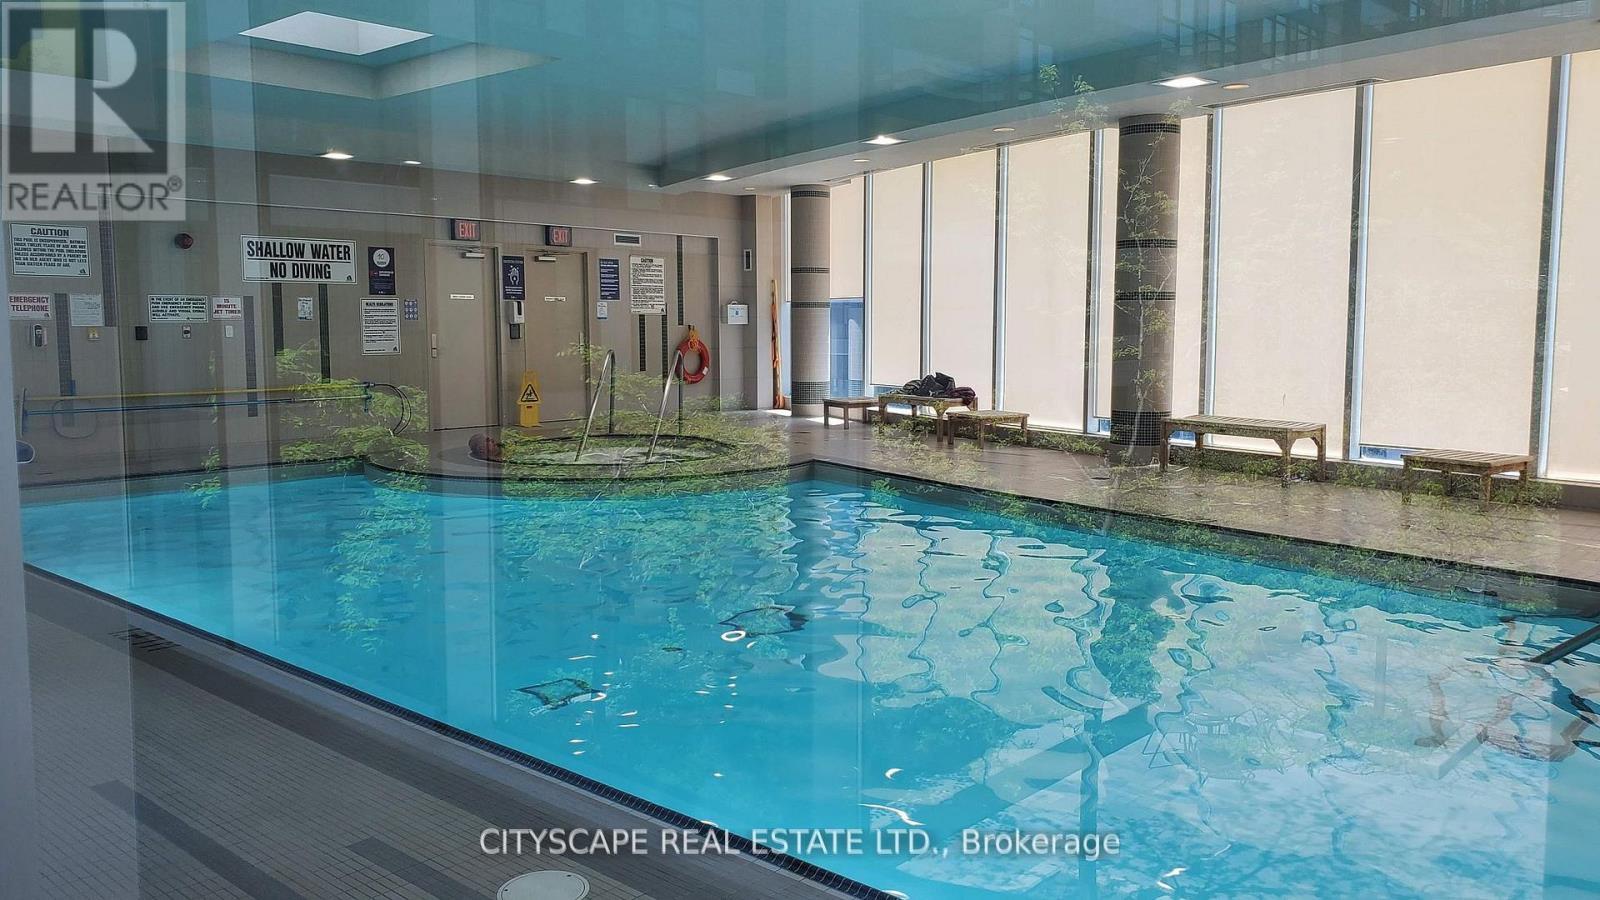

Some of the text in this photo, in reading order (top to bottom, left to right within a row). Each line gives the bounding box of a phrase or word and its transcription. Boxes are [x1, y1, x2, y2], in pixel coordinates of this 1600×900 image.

[30, 228, 70, 236] CAUTION
[460, 223, 476, 238] EXIT
[553, 229, 568, 242] EXIT
[246, 240, 351, 260] SHALLOW WATER
[270, 262, 331, 279] NO DIVING
